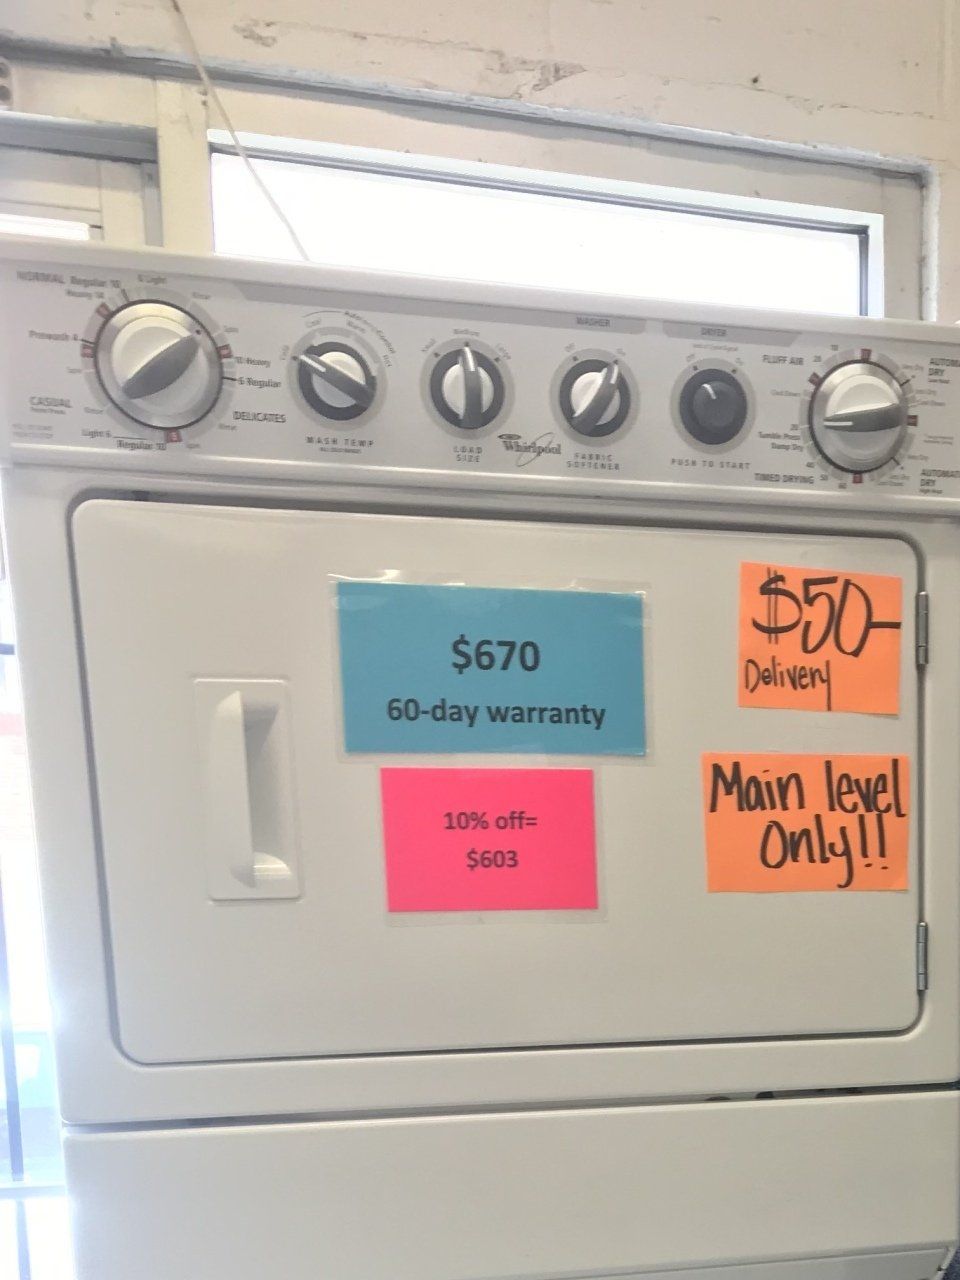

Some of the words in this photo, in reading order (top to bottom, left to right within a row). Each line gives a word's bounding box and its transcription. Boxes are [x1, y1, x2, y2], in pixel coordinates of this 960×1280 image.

[576, 316, 611, 328] WASHER
[701, 327, 727, 337] DRYER
[762, 354, 788, 364] FLUFF
[789, 356, 804, 366] AIR
[928, 367, 945, 377] DRY
[233, 410, 287, 424] DELICATES
[306, 436, 338, 446] WASH
[344, 438, 375, 447] TEMP
[453, 445, 483, 454] LOAD
[503, 439, 562, 457] Whirlpool
[456, 455, 481, 463] SIZE
[574, 452, 613, 462] FABRIC
[567, 461, 620, 471] SOFTENER
[671, 457, 697, 467] PUSH
[702, 460, 714, 469] TO
[719, 461, 751, 470] START
[754, 472, 781, 483] TIMED
[781, 474, 815, 484] DRYING
[920, 478, 936, 487] DRY
[451, 634, 541, 675] $670
[745, 656, 831, 711] Delivery
[386, 697, 480, 728] 60-day
[487, 703, 607, 731] warranty
[709, 761, 805, 813] Main
[824, 758, 907, 818] level
[443, 811, 489, 831] 10%
[495, 810, 538, 831] off=
[760, 812, 889, 889] Only!!
[466, 847, 519, 872] $603
